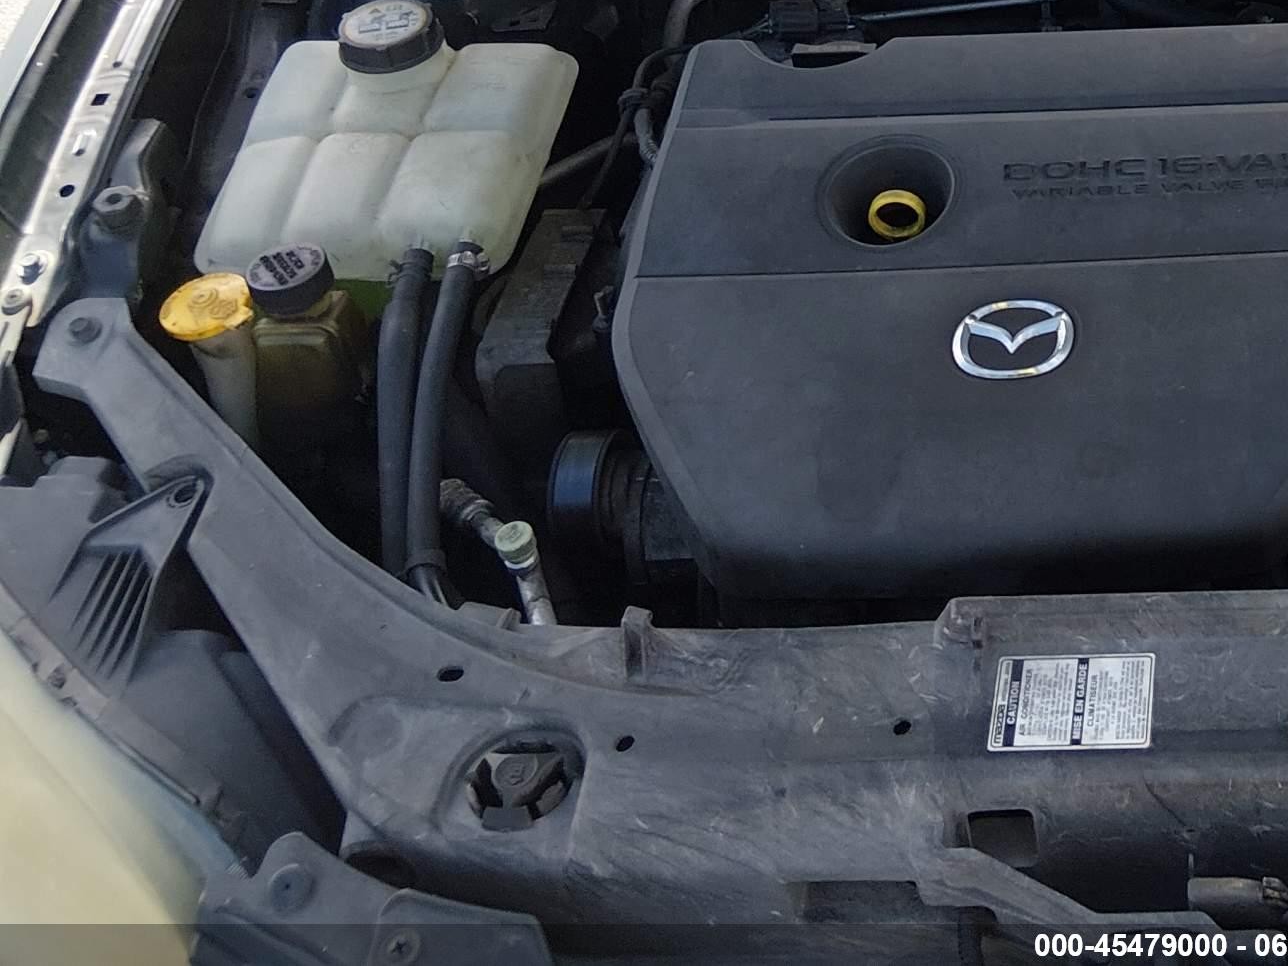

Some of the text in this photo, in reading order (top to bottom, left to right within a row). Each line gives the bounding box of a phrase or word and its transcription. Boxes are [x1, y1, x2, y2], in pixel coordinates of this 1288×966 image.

[1003, 158, 1145, 180] DOHC
[1012, 184, 1148, 199] VARIABLE
[1161, 179, 1244, 194] VALVE
[1007, 681, 1020, 725] CAUTION
[1018, 668, 1033, 736] AIR CONDITIONER
[1072, 663, 1088, 740] MISE EN GARDE
[1087, 674, 1098, 727] CLIMATISEUR
